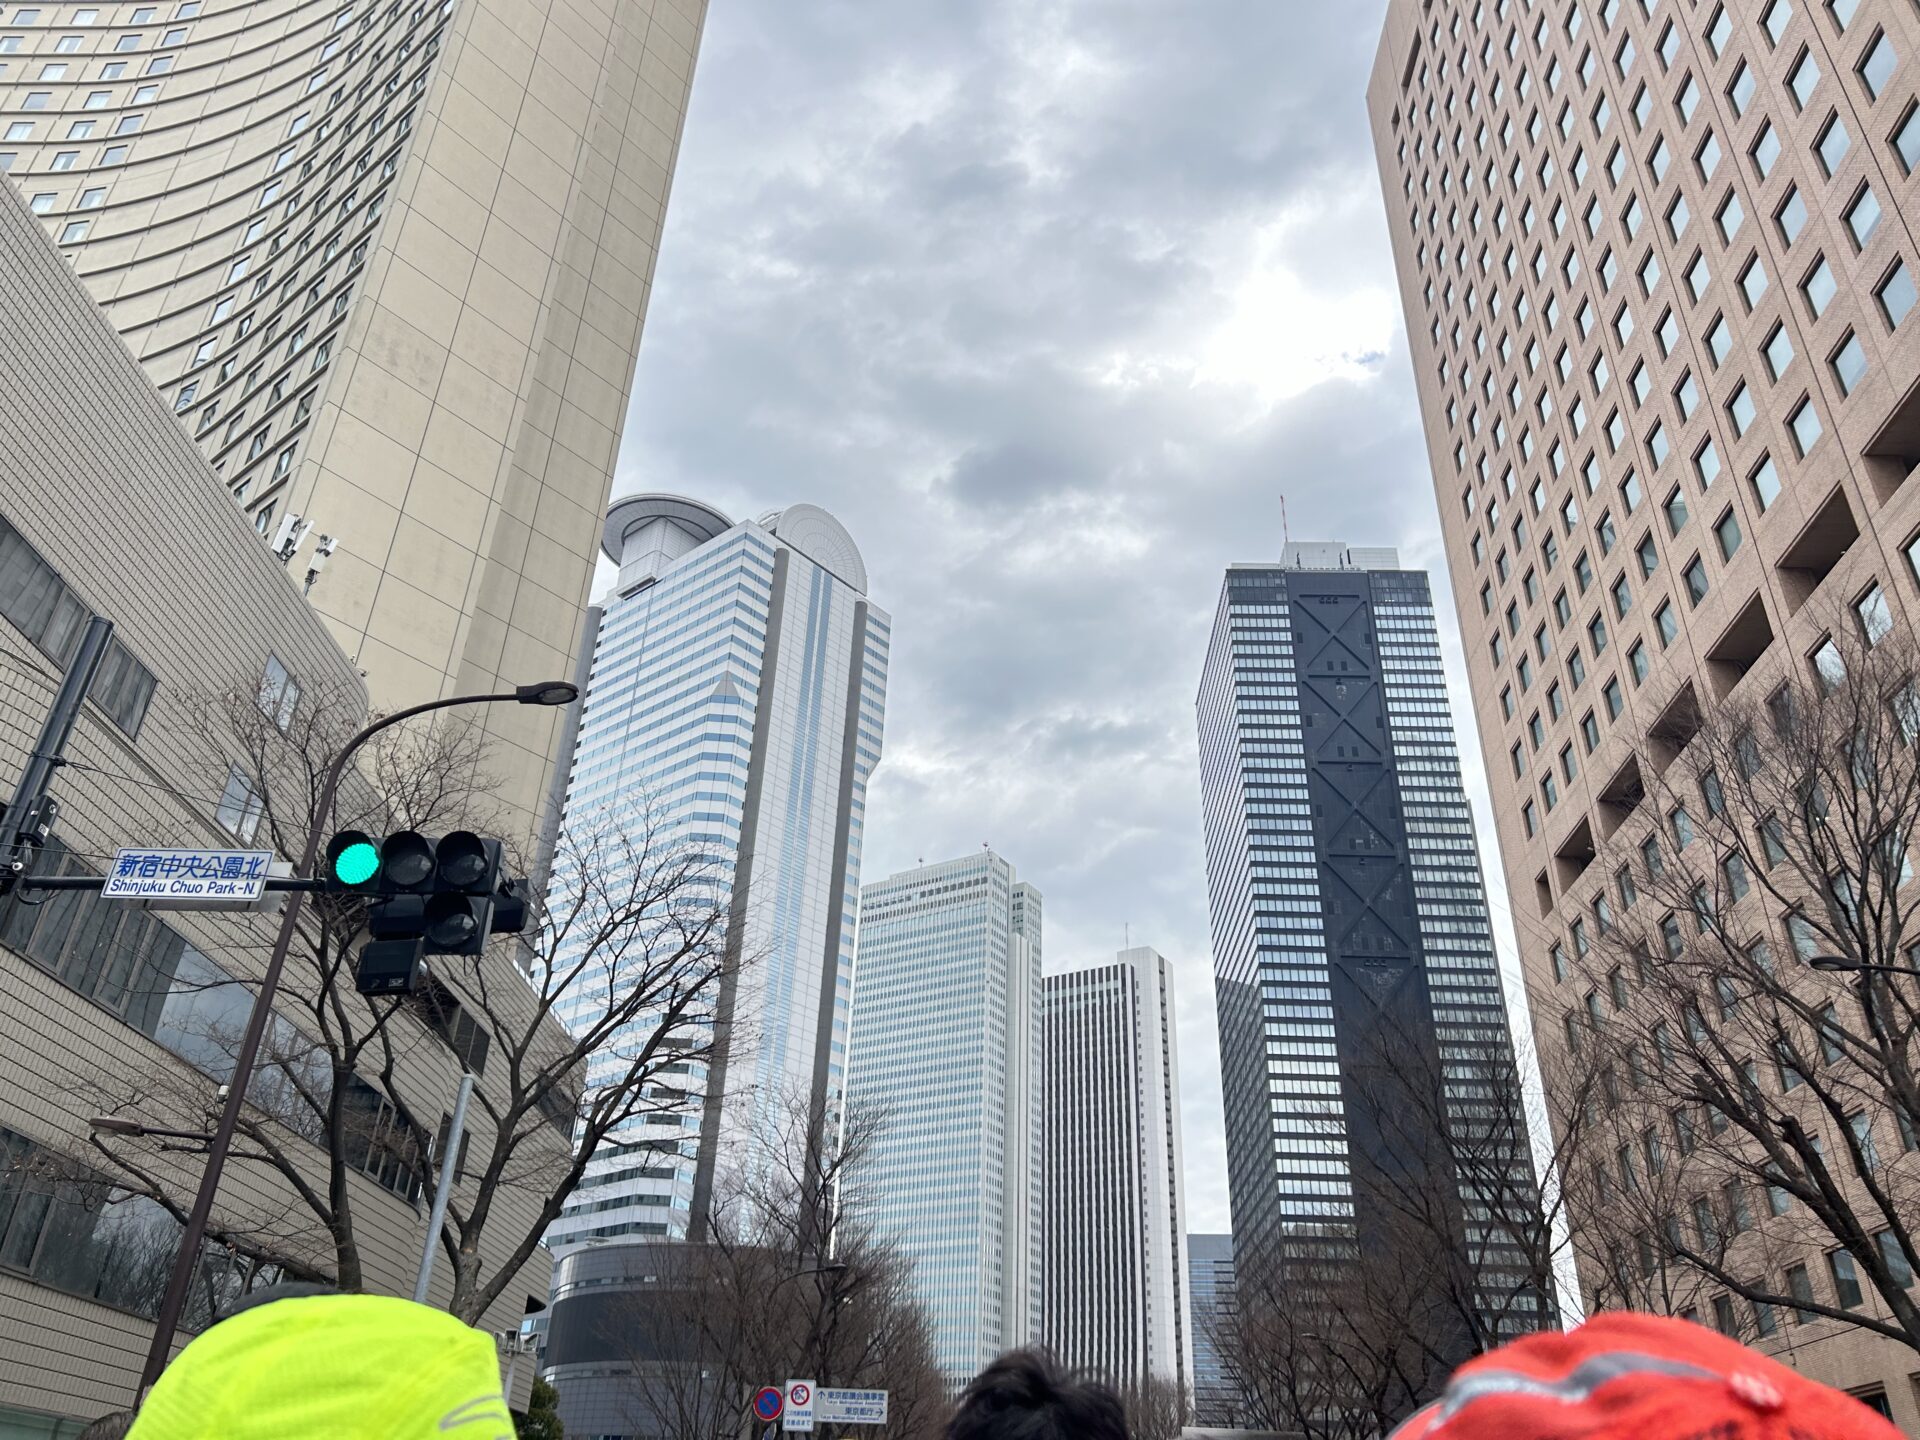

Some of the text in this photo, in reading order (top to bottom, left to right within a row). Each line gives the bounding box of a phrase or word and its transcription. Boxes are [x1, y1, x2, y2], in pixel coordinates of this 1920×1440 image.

[116, 854, 265, 880] 新宿中央公園北
[110, 879, 166, 895] Shinjuku
[170, 881, 203, 893] Chuo
[845, 1407, 874, 1416] 東京都庁
